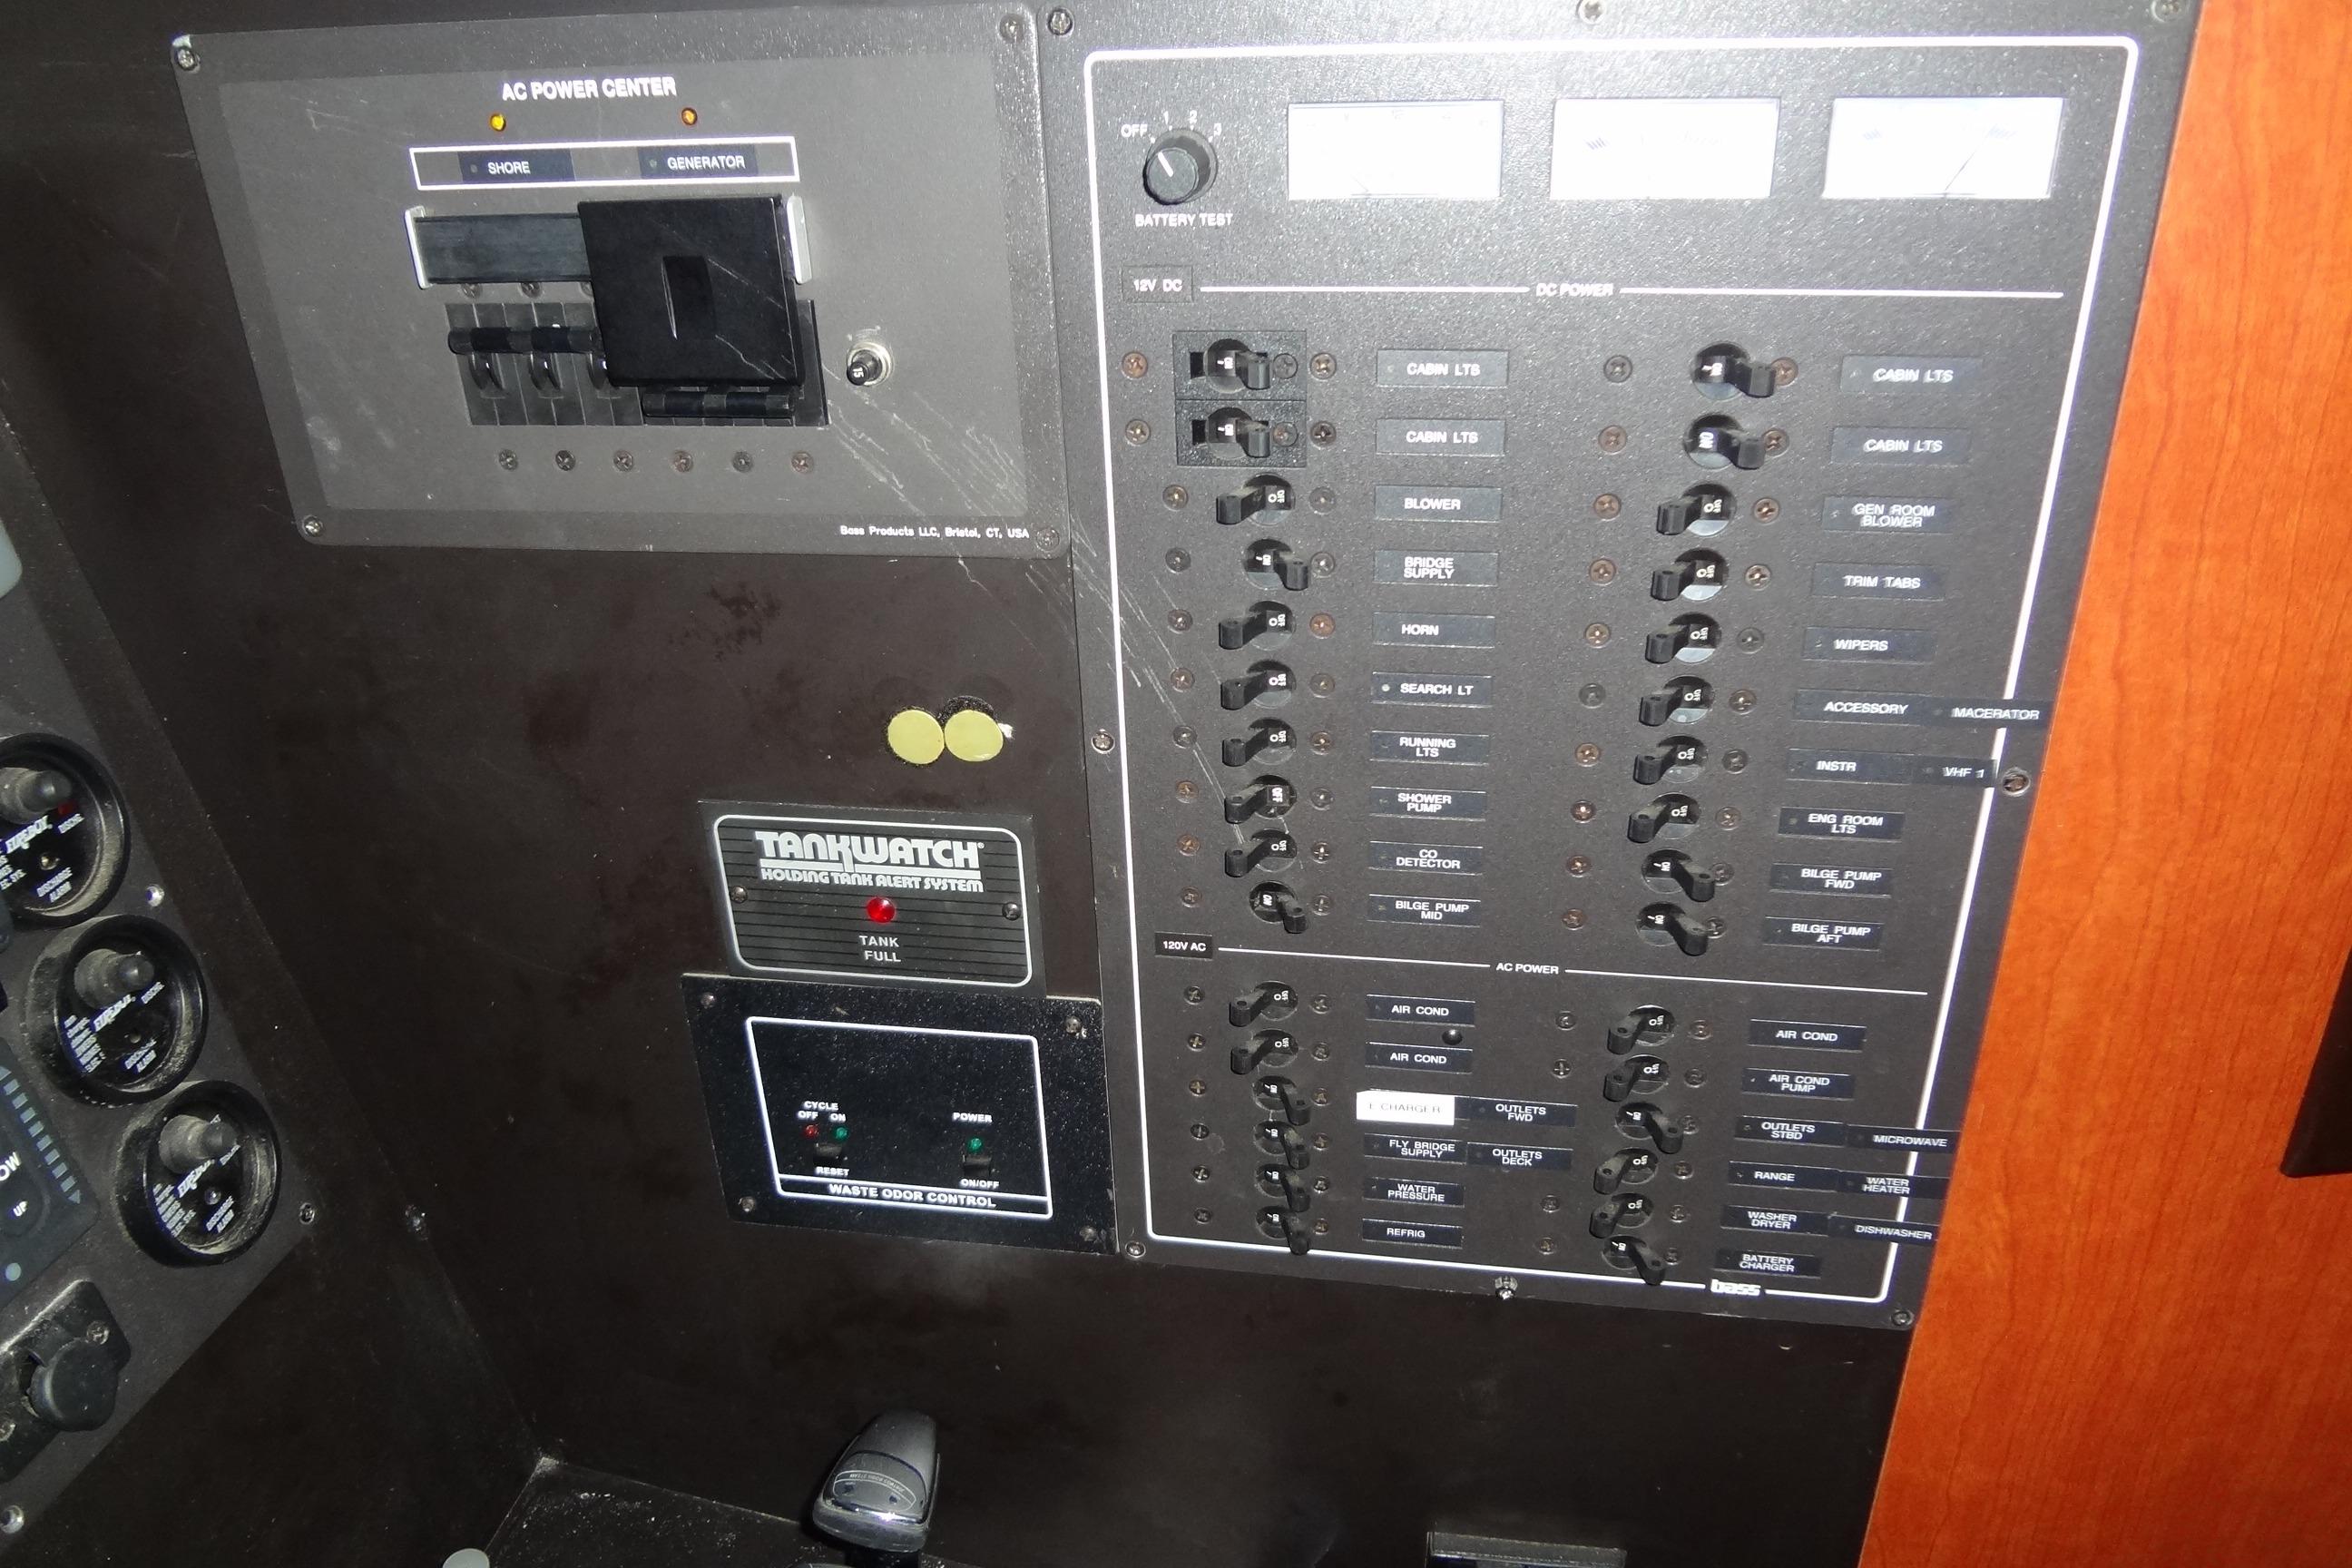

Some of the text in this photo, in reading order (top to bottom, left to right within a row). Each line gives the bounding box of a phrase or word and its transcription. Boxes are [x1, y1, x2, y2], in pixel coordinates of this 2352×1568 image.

[502, 76, 677, 101] AC POWER CENTER
[1163, 112, 1169, 123] 1
[1189, 110, 1197, 123] 2
[1121, 124, 1147, 138] OFF
[1214, 123, 1222, 136] 3
[487, 161, 531, 175] SHORE
[667, 154, 745, 171] GENERATOR
[1134, 213, 1233, 227] BATTERY TEST
[1133, 279, 1182, 292] 12V DC
[1536, 284, 1613, 297] DC POWER
[853, 367, 864, 377] 15
[1407, 363, 1481, 377] CABIN LTS
[1873, 368, 1954, 383] CABIN LTS
[1406, 431, 1478, 444] CABIN LTS
[1863, 439, 1943, 454] CABIN LTS
[1404, 498, 1461, 510] BLOWER
[1852, 504, 1936, 517] GEN ROOM
[1860, 514, 1923, 528] BLOWER
[840, 524, 1029, 540] Bass Products LLC, Bristol, CT, USA
[1404, 556, 1454, 568] BRIDGE
[1404, 567, 1455, 579] SUPPLY
[1843, 574, 1921, 589] TRIM TABS
[1401, 624, 1439, 635] HORN
[1834, 639, 1888, 651] WIPERS
[1400, 683, 1474, 695] SEARCH LT
[1824, 701, 1908, 714] ACCESSORY
[1951, 708, 2040, 720] MACERATOR
[1399, 737, 1456, 749] RUNNING
[1416, 748, 1439, 757] LTS
[1816, 760, 1857, 771] INSTR
[1943, 767, 1984, 779] VHF 1
[1397, 793, 1452, 804] SHOWER
[1406, 803, 1442, 813] PUMP
[1808, 813, 1884, 826] ENG ROOM
[1831, 824, 1857, 834] LTS
[1419, 849, 1437, 858] CO
[1396, 858, 1461, 869] DETECTOR
[760, 867, 984, 893] HOLDING TANK ALERT SYSTEM
[1800, 868, 1882, 881] BILGE PUMP
[1825, 878, 1855, 889] FWD
[1395, 900, 1469, 913] BILGE PUMP
[1421, 911, 1443, 920] MID
[1791, 923, 1871, 936] BILGE PUMP
[859, 936, 899, 947] TANK
[1817, 934, 1842, 943] AFT
[1162, 940, 1206, 951] 120V AC
[865, 950, 901, 963] FULL
[1496, 963, 1559, 975] AC POWER
[1391, 1005, 1449, 1016] AIR COND
[1776, 1030, 1838, 1042] AIR COND
[1390, 1052, 1447, 1063] AIR COND
[1769, 1073, 1830, 1086] AIR COND
[1780, 1083, 1816, 1093] PUMP
[803, 1100, 838, 1112] CYCLE
[1495, 1103, 1546, 1115] OUTLETS
[798, 1110, 818, 1120] OFF
[830, 1112, 847, 1122] ON
[953, 1112, 993, 1123] POWER
[1507, 1112, 1534, 1122] FWD
[1761, 1122, 1815, 1133] OUTLETS
[1771, 1130, 1803, 1140] STBD
[1873, 1134, 1948, 1147] MICROWAVE
[1389, 1140, 1455, 1152] FLY BRIDGE
[1401, 1147, 1443, 1159] SUPPLY
[1493, 1149, 1543, 1160] OUTLETS
[0, 1151, 21, 1182] OW
[1502, 1157, 1533, 1166] DECK
[816, 1167, 849, 1177] RESET
[1754, 1171, 1795, 1181] RANGE
[960, 1178, 999, 1190] ON/OFF
[1397, 1183, 1436, 1193] WATER
[1866, 1177, 1909, 1187] WATER
[1862, 1184, 1910, 1194] HEATER
[829, 1183, 996, 1208] WASTE ODOR CONTROL
[1387, 1191, 1445, 1202] PRESSURE
[13, 1200, 29, 1217] UP
[1748, 1210, 1798, 1221] WASHER
[1750, 1220, 1791, 1230] DRYER
[1387, 1228, 1426, 1238] REFRIG
[1855, 1224, 1933, 1240] DISHWASHER
[1742, 1254, 1794, 1265] BATTERY
[1740, 1260, 1795, 1272] CHARGER
[1710, 1279, 1761, 1296] bass
